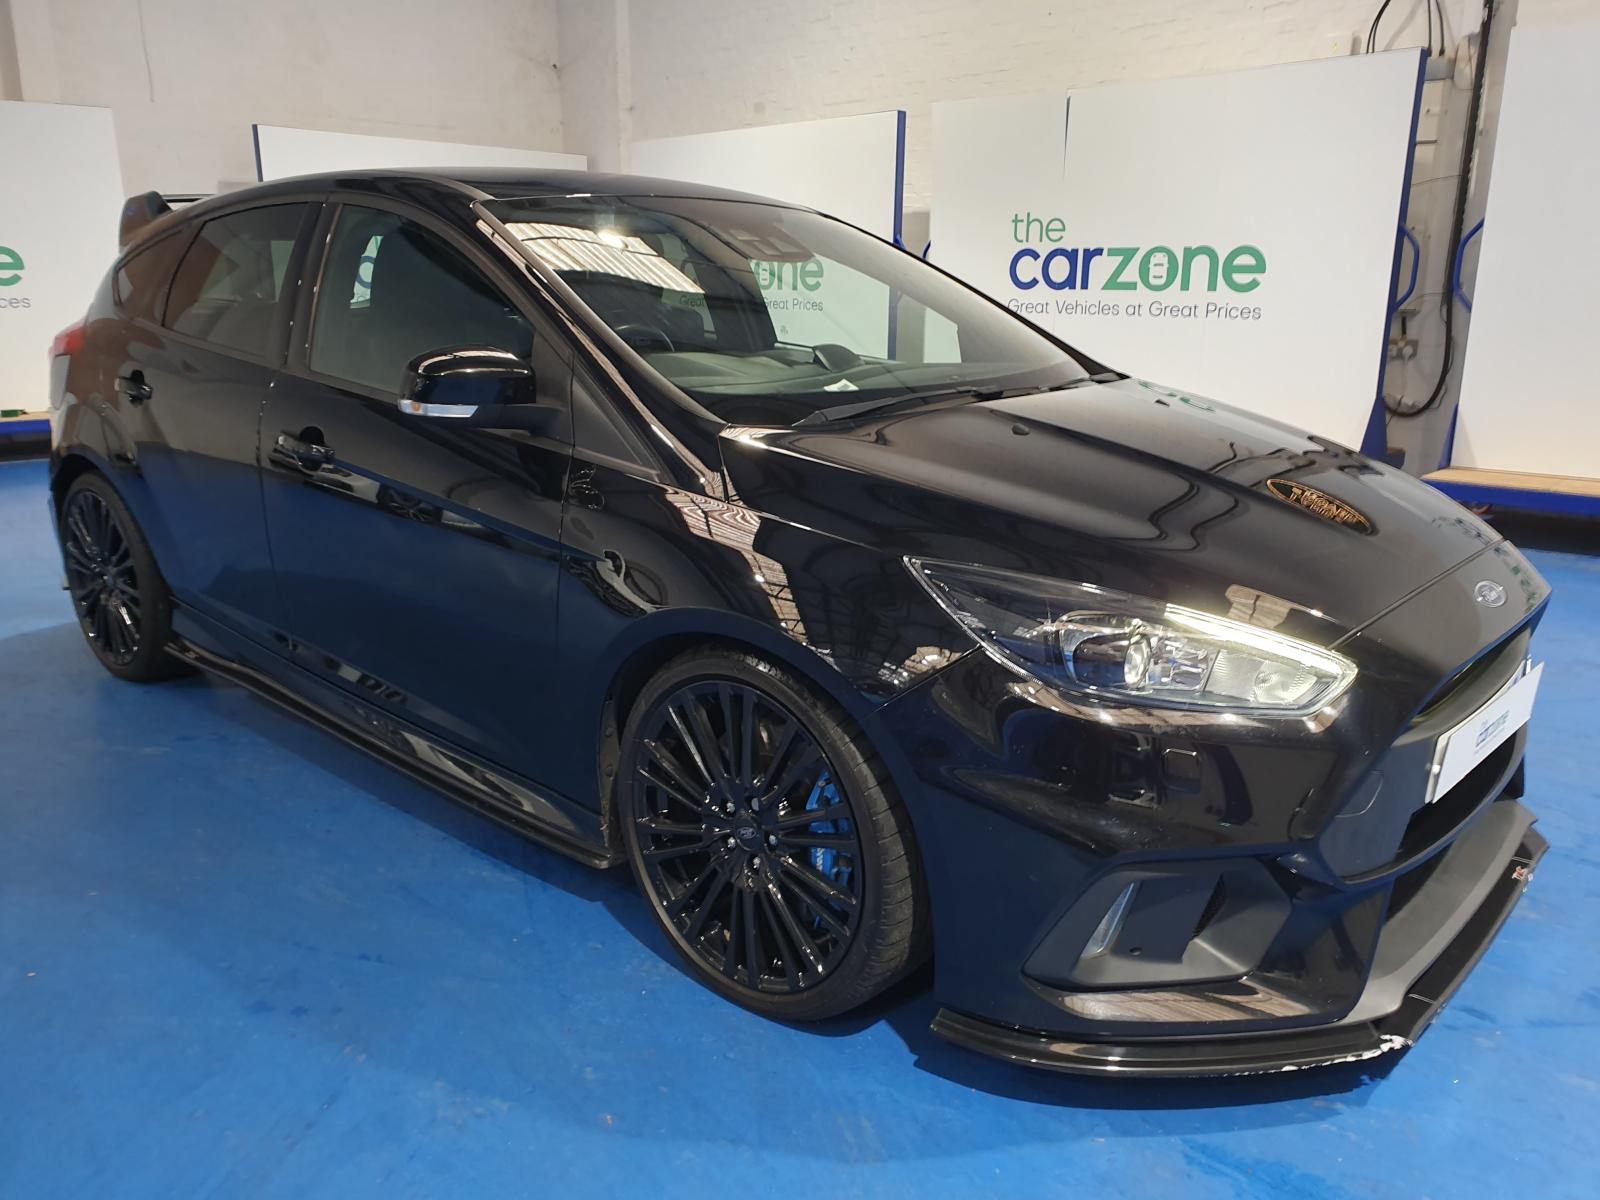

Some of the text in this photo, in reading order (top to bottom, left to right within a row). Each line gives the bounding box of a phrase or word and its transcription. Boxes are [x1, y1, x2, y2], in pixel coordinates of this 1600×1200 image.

[1011, 211, 1066, 243] the
[1009, 245, 1266, 293] carzone
[792, 298, 824, 312] Prices
[1007, 298, 1262, 320] Great Vehicles at Great Prices
